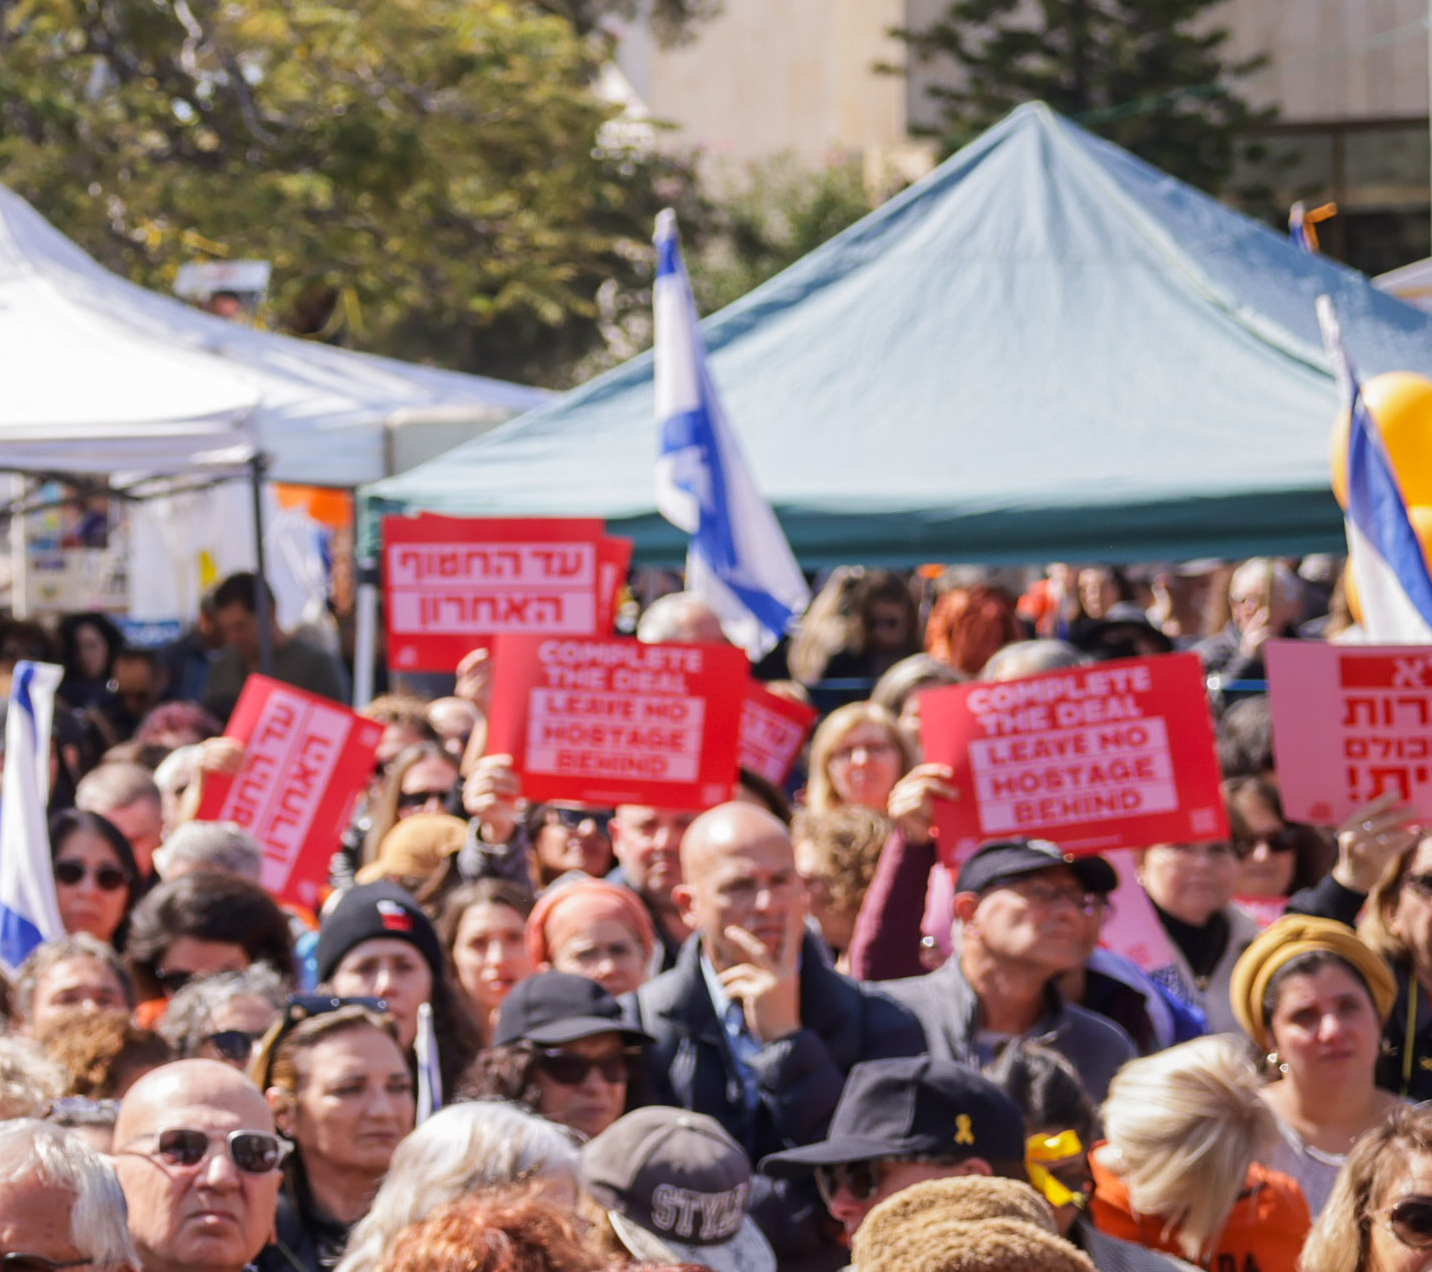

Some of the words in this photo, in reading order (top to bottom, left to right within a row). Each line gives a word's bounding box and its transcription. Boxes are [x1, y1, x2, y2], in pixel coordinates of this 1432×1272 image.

[400, 550, 521, 581] החטוף
[530, 550, 582, 578] עד
[420, 596, 562, 626] האחרון
[538, 640, 703, 673] COMPLETE
[544, 666, 604, 689] THE
[612, 669, 690, 694] DEAL
[967, 665, 1152, 715] COMPLETE
[546, 694, 635, 717] LEAVE
[644, 701, 689, 721] NO
[977, 704, 1050, 736] THE
[1057, 695, 1143, 728] DEAL
[543, 725, 686, 750] HOSTAGE
[987, 733, 1089, 766] LEAVE
[1099, 724, 1149, 749] NO
[557, 752, 668, 773] BEHIND
[991, 756, 1155, 797] HOSTAGE
[1013, 788, 1143, 824] BEHIND
